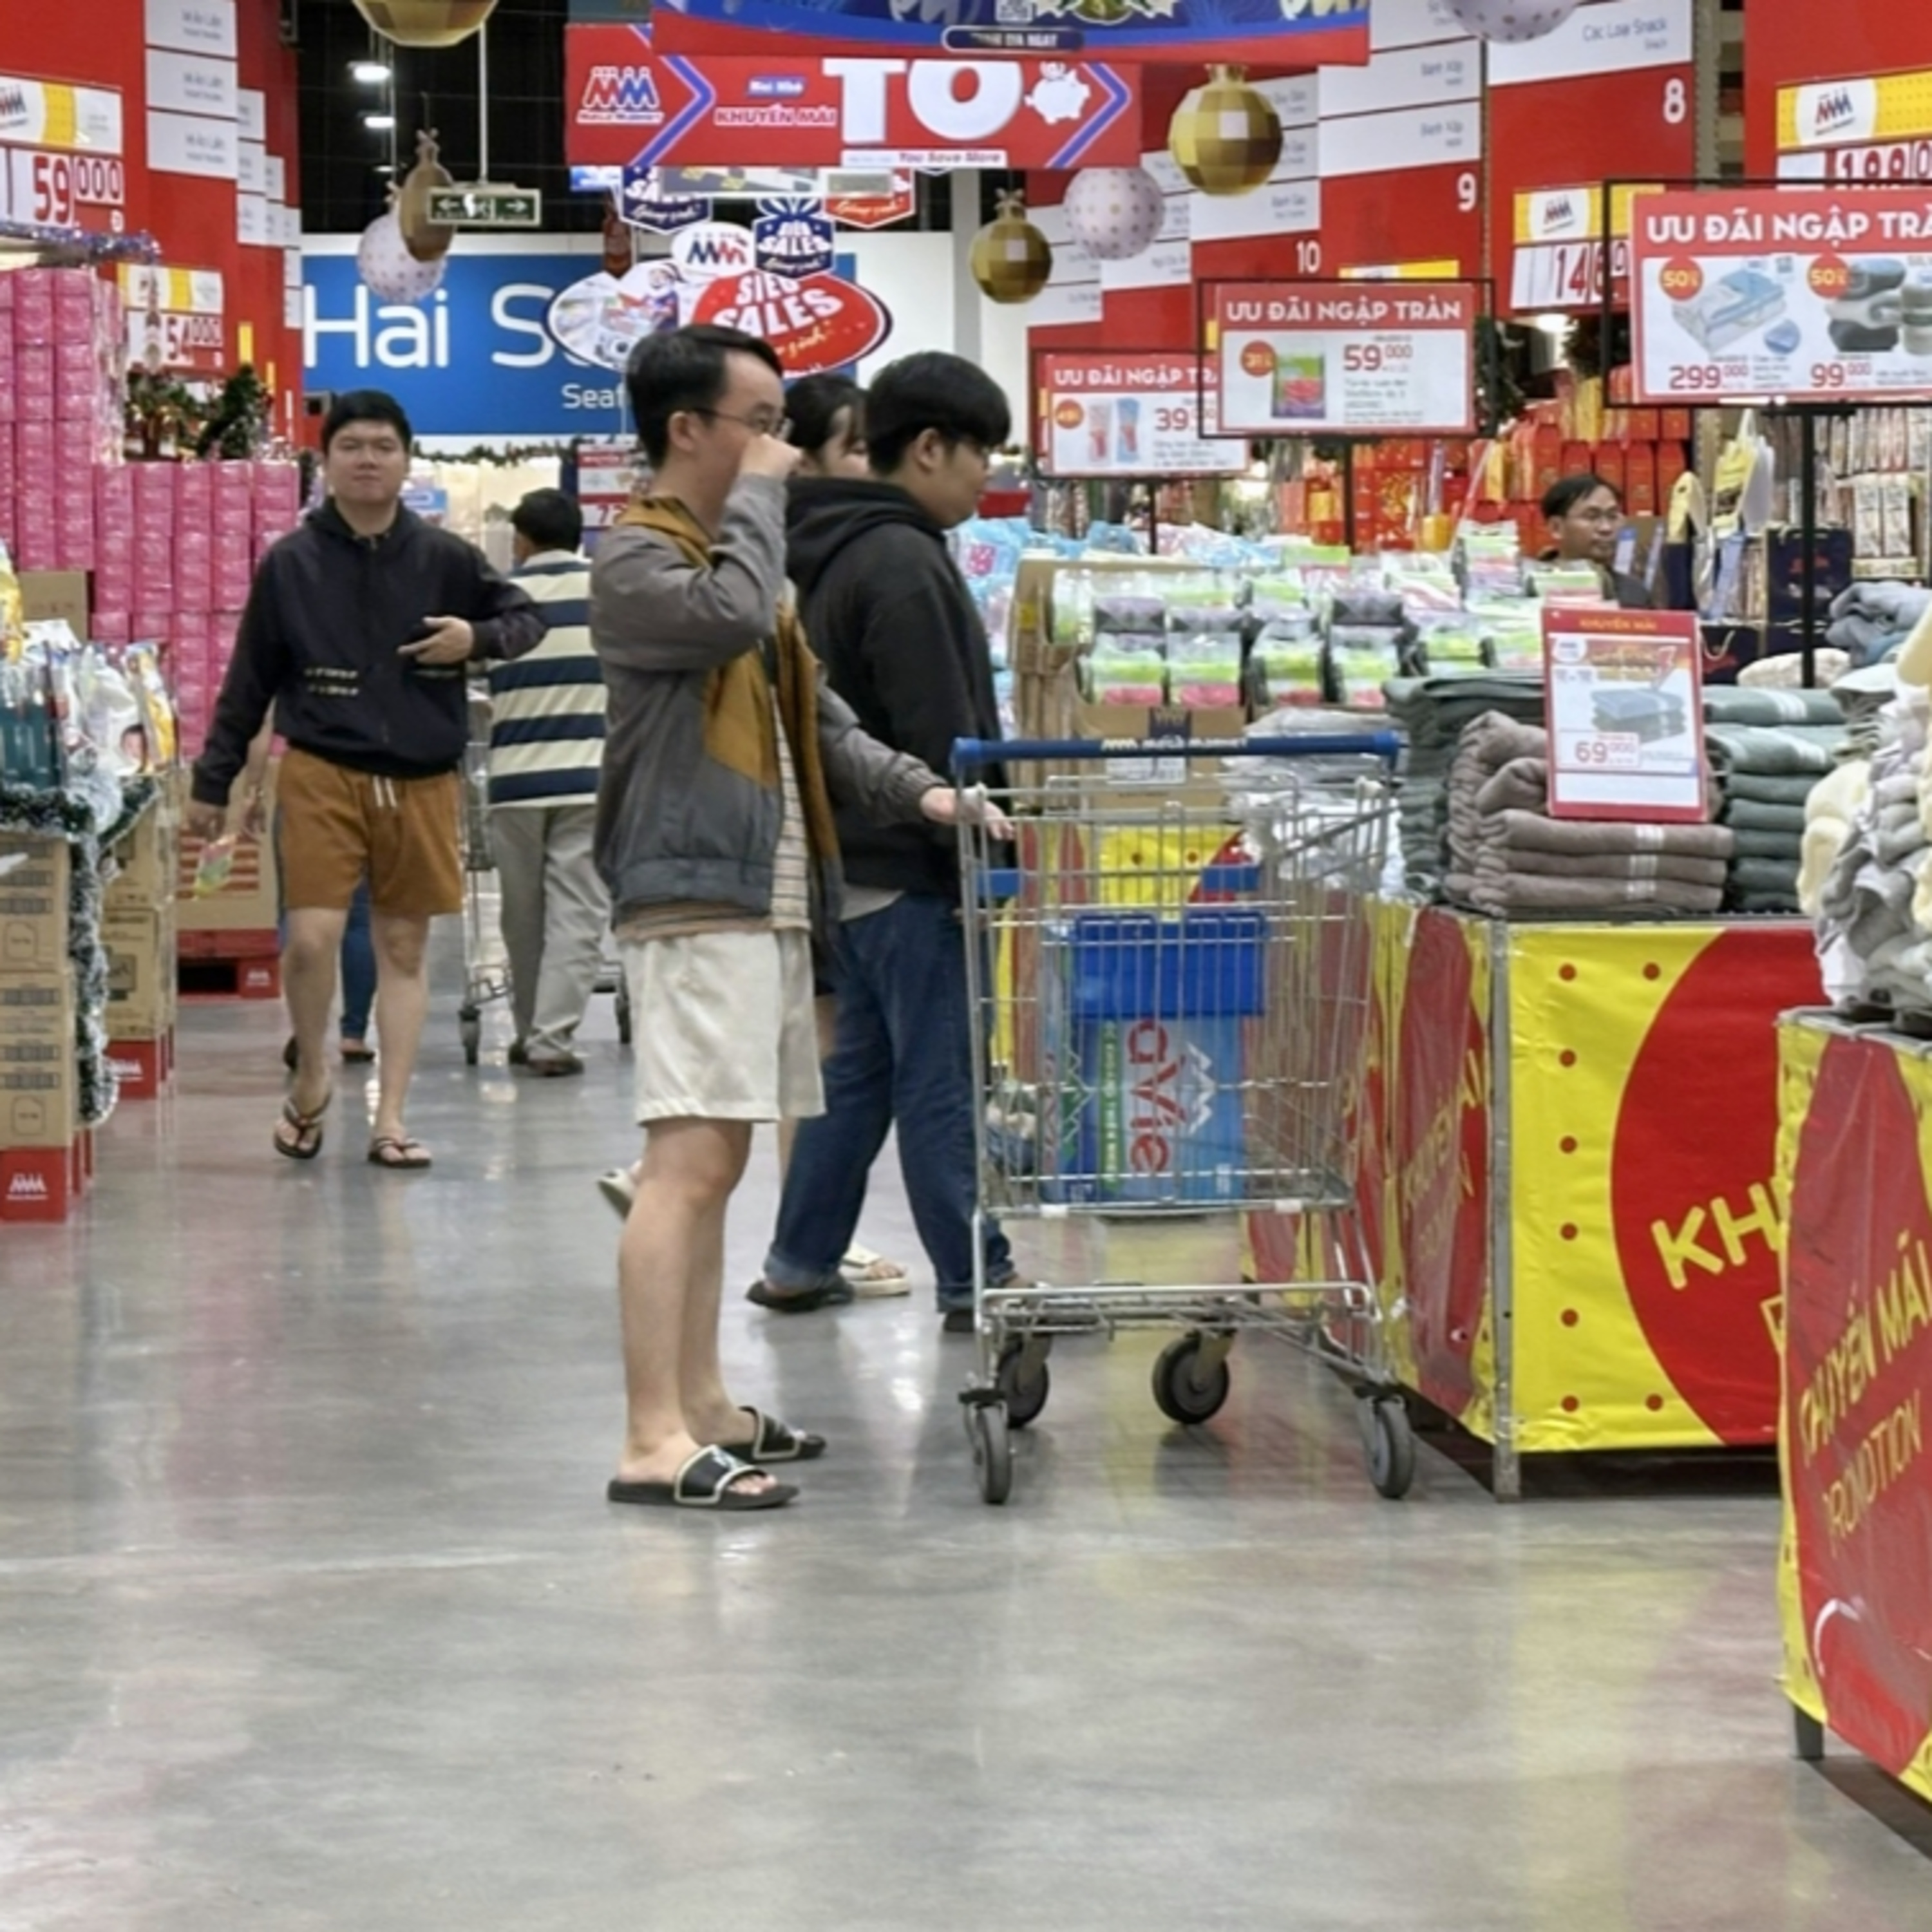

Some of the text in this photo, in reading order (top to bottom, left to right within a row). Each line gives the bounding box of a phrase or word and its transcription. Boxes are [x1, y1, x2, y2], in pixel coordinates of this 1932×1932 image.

[1663, 79, 1685, 122] 8
[33, 155, 120, 224] 59 000
[1458, 173, 1477, 211] 9
[1704, 208, 1763, 242] ĐÃI
[1773, 205, 1869, 249] NGẬP
[1878, 203, 1932, 240] TRÀ
[1297, 241, 1321, 274] 10
[303, 283, 450, 368] Hai
[712, 289, 844, 337] SALES
[1268, 296, 1310, 321] ĐÃI
[1318, 295, 1388, 326] NGẬP
[1394, 294, 1462, 320] TRÀN
[1343, 343, 1412, 372] 59 000
[1087, 364, 1122, 385] ĐÃI
[1128, 364, 1182, 388] NGẬP
[1186, 368, 1218, 384] TR
[1669, 365, 1721, 390] 299
[1723, 364, 1749, 377] 000
[1811, 363, 1845, 388] 99
[1846, 362, 1872, 375] 000
[562, 381, 630, 403] Seaf
[1154, 407, 1190, 432] 39
[1575, 742, 1607, 762] 69
[1129, 1019, 1187, 1173] aVie
[1651, 1176, 1785, 1290] KH
